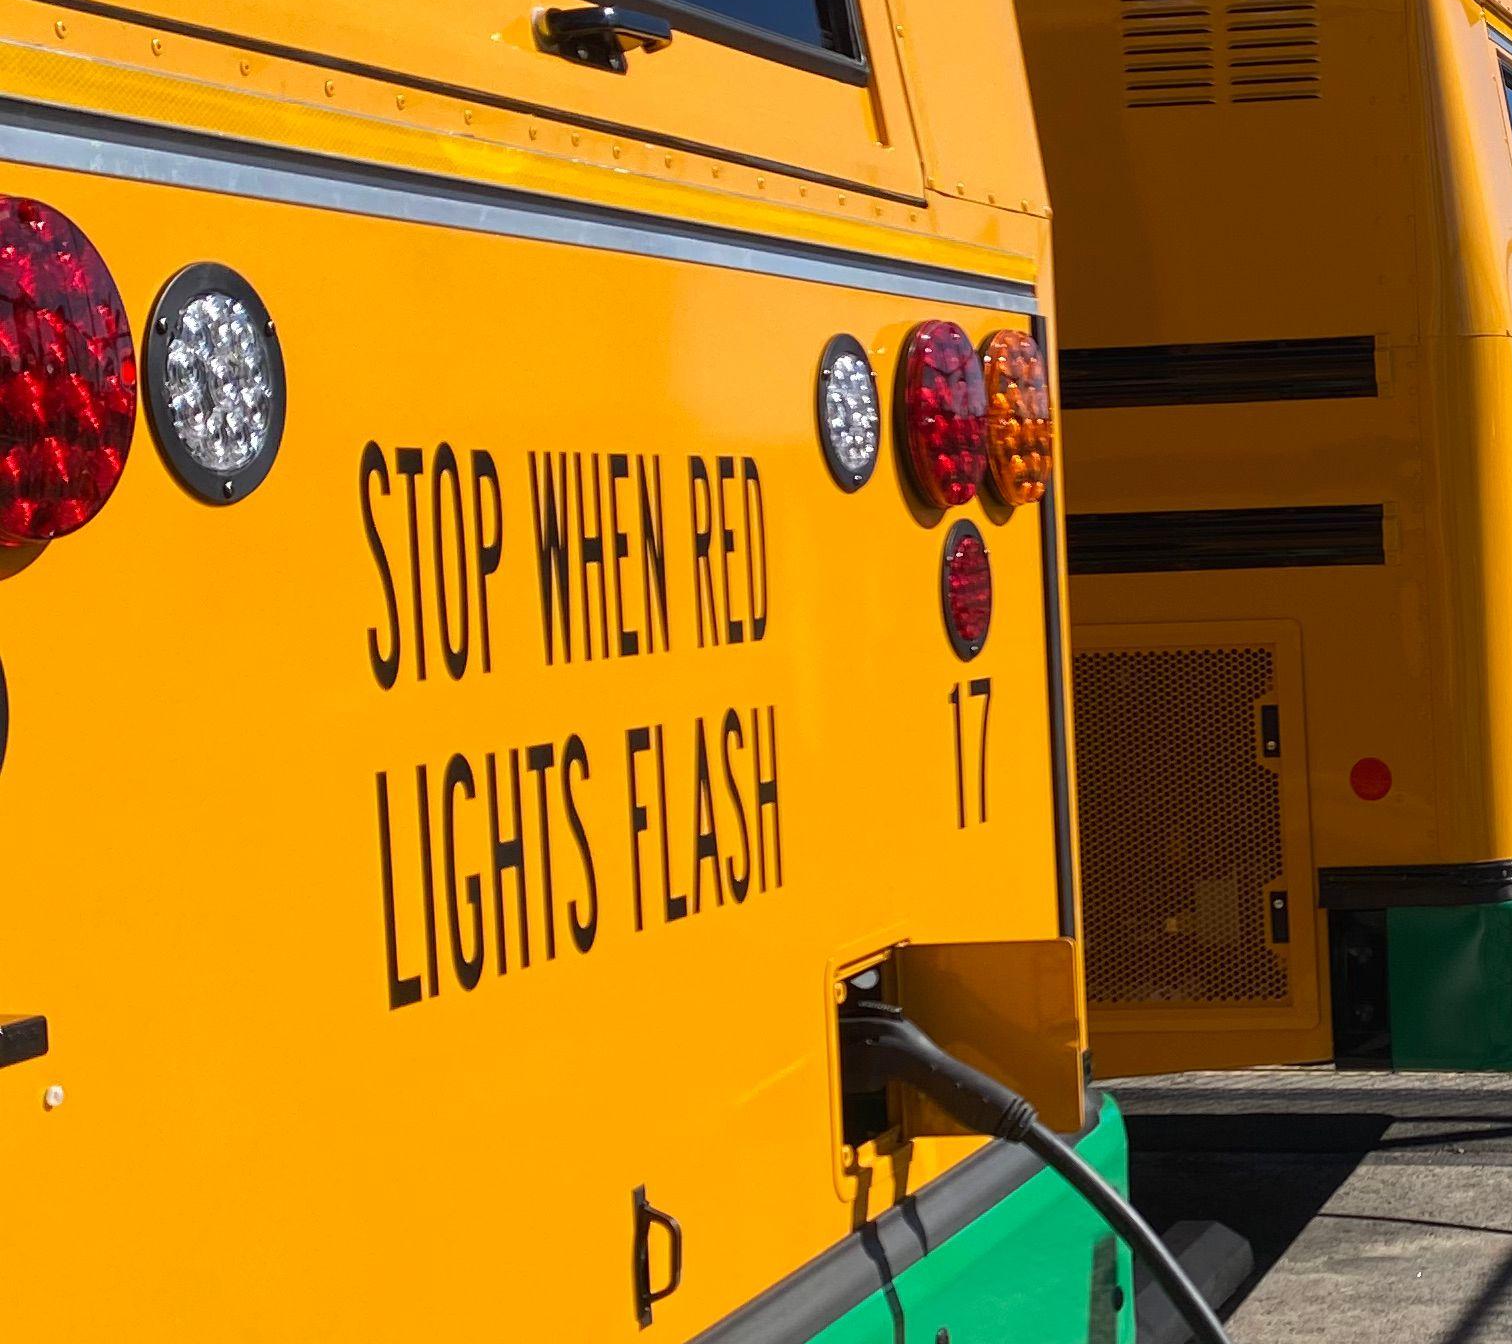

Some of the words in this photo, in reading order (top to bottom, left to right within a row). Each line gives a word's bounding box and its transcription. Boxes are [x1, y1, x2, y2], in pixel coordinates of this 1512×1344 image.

[359, 439, 502, 691] STOP
[527, 450, 670, 666] WHEN
[688, 455, 768, 648] RED
[375, 733, 598, 1012] LIGHTS
[624, 705, 783, 932] FLASH
[948, 678, 992, 829] 17
